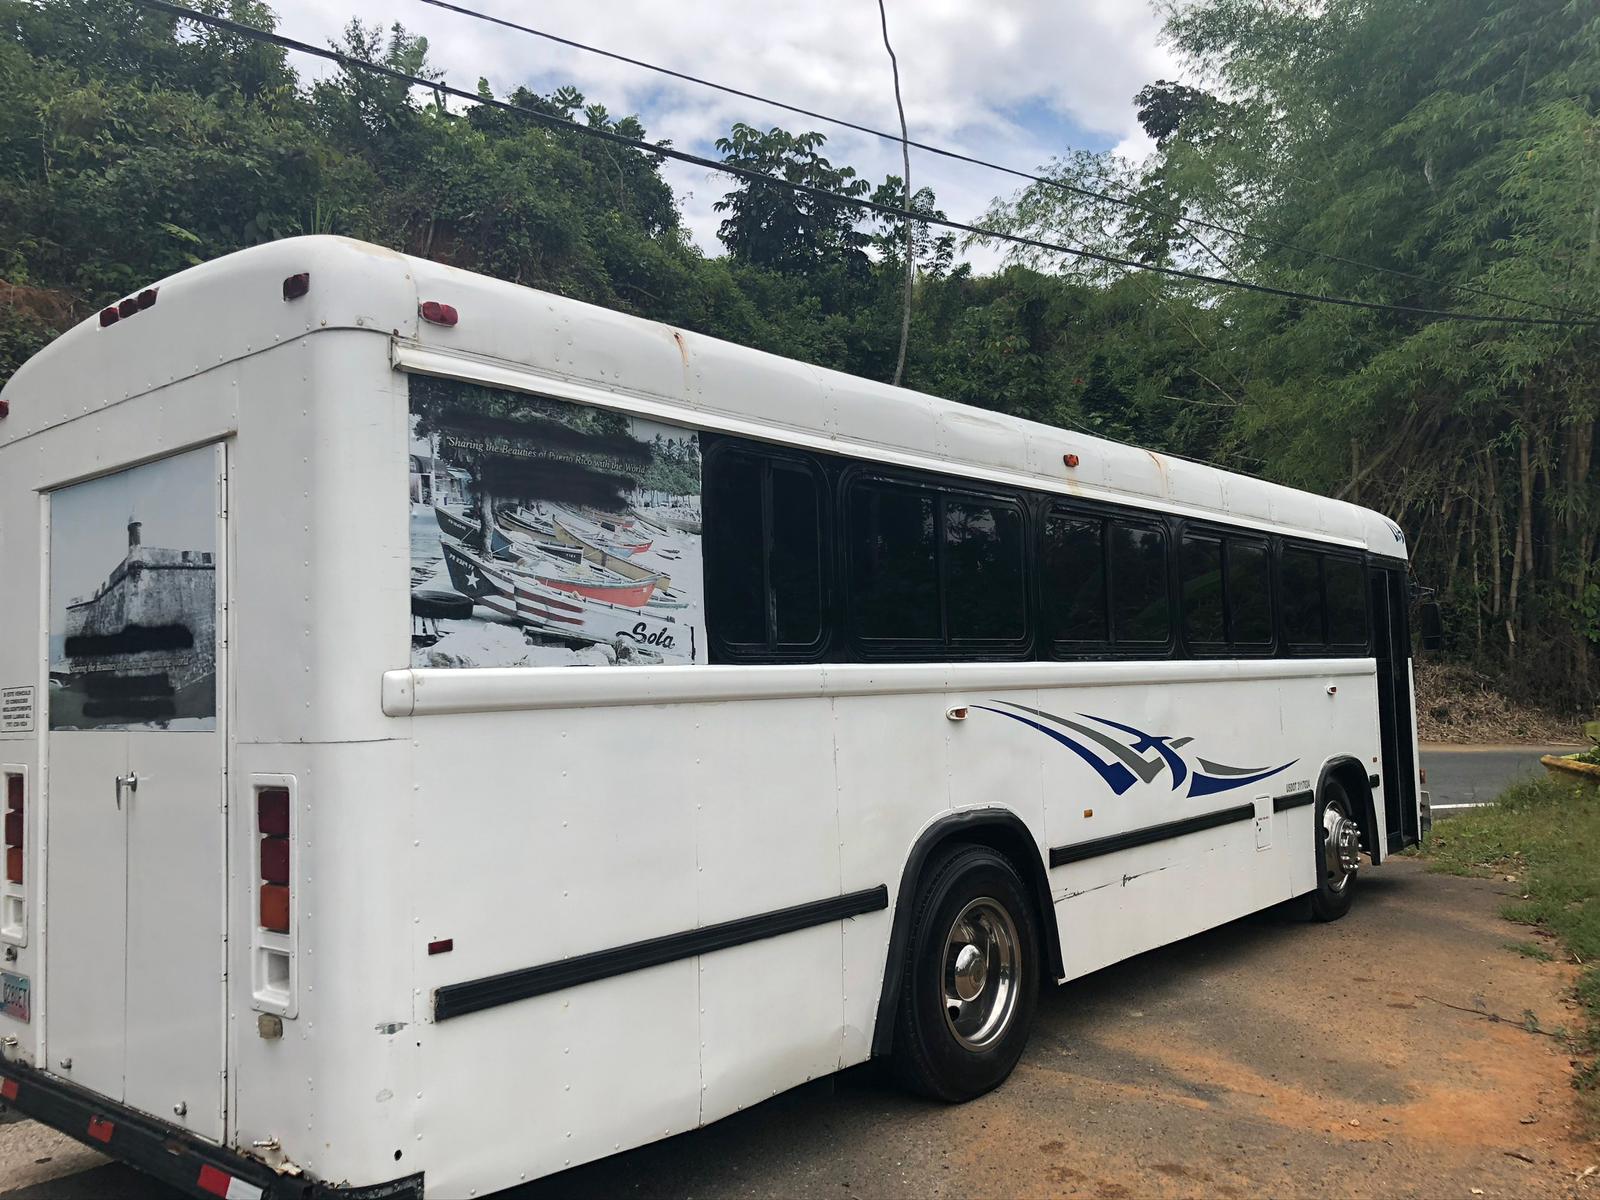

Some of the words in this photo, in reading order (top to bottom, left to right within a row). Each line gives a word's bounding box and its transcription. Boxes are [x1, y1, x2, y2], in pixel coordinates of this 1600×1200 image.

[485, 441, 500, 453] the
[501, 444, 537, 458] Beauties
[575, 454, 593, 466] Rico
[594, 459, 610, 469] with
[611, 461, 623, 471] the
[615, 621, 675, 649] Sola
